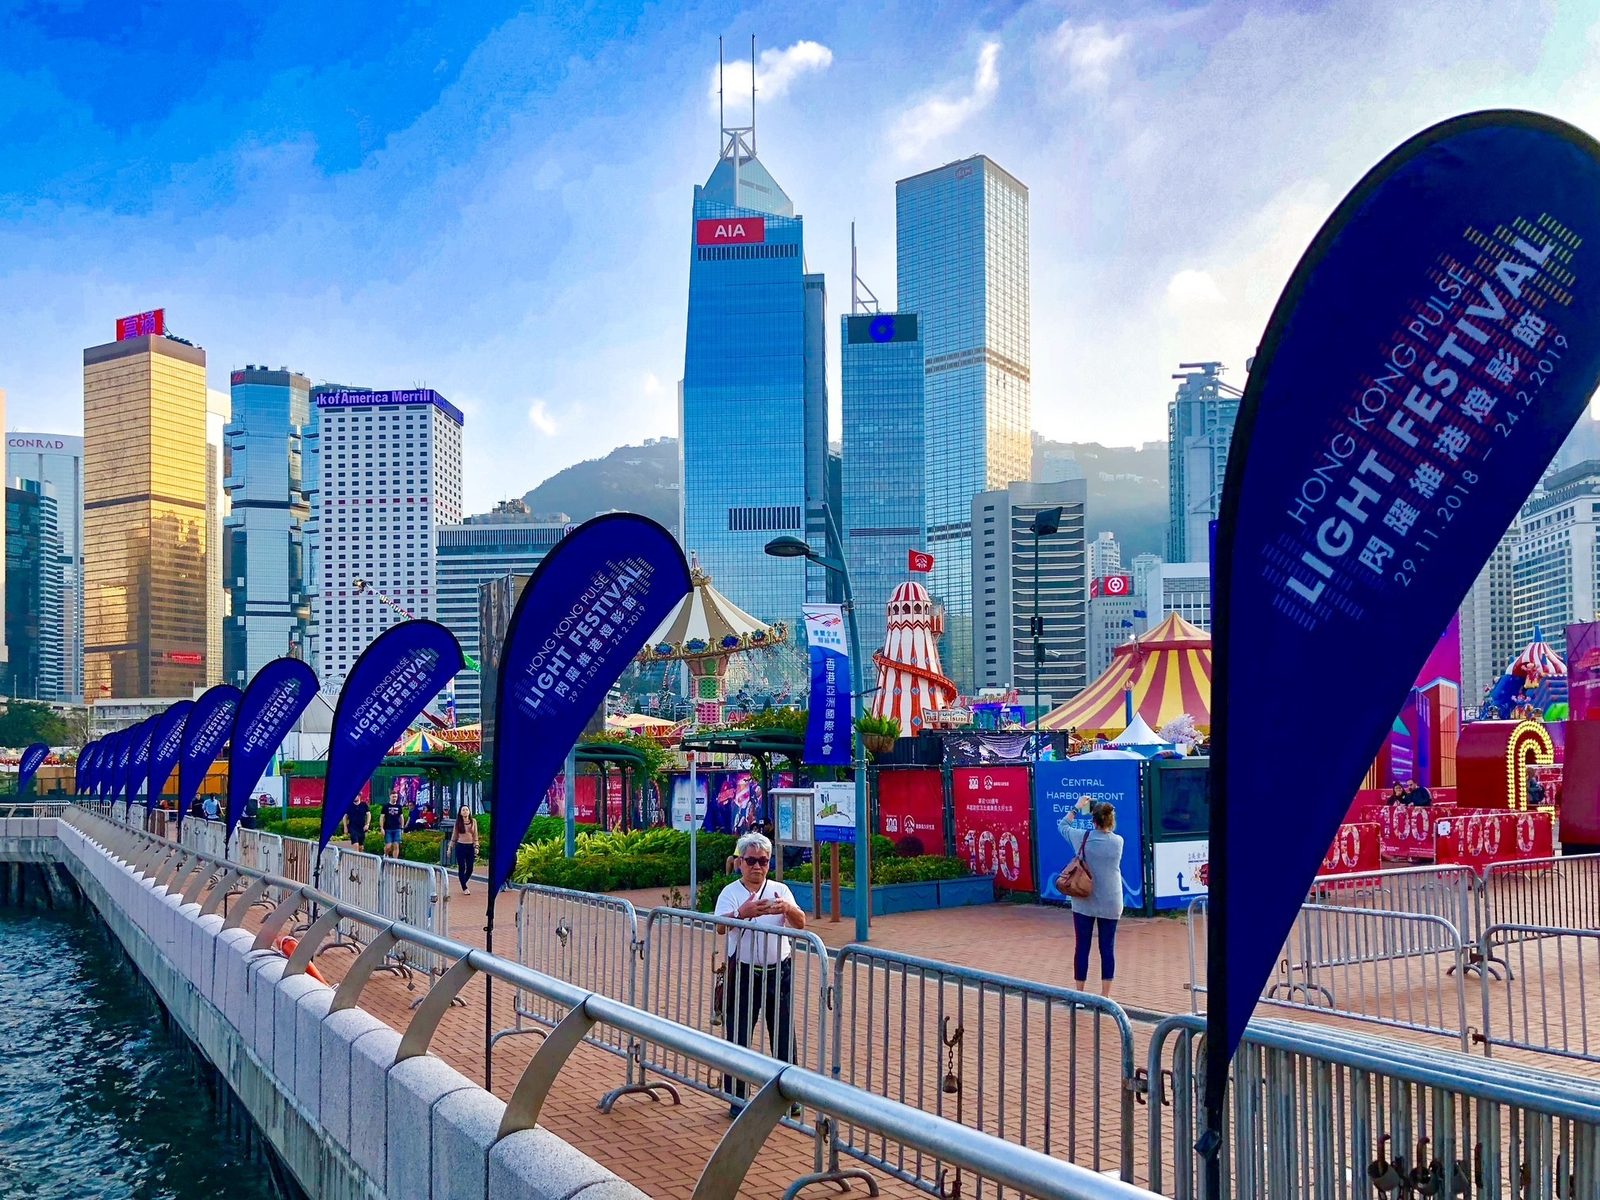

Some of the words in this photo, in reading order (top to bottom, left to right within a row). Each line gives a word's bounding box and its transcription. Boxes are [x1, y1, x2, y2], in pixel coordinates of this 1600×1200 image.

[714, 224, 746, 238] AIA
[328, 393, 340, 405] of
[341, 391, 388, 403] America
[391, 390, 430, 402] Merrill
[1286, 448, 1396, 604] LIGHT
[1386, 237, 1556, 448] FESTIVAL
[1287, 433, 1355, 525] HONG
[1348, 343, 1417, 431] KONG
[1408, 263, 1474, 342] PULSE
[8, 438, 64, 449] CONRAD
[524, 645, 573, 709] LIGHT
[568, 566, 643, 646] FESTIVAL
[526, 638, 556, 676] HONG
[553, 604, 584, 639] KONG
[581, 574, 610, 605] PULSE
[349, 701, 382, 740] LIGHT
[381, 653, 431, 702] FESTIVAL
[352, 696, 373, 720] HONG
[371, 675, 392, 697] KONG
[390, 657, 410, 677] PULSE
[189, 734, 207, 758] LIGHT
[205, 703, 232, 735] FESTIVAL
[243, 722, 265, 752] LIGHT
[263, 682, 296, 723] FESTIVAL
[156, 741, 171, 761] LIGHT
[1061, 777, 1104, 787] CENTRAL
[1380, 805, 1430, 841] 100
[1455, 815, 1501, 857] 100
[964, 830, 1020, 881] 100
